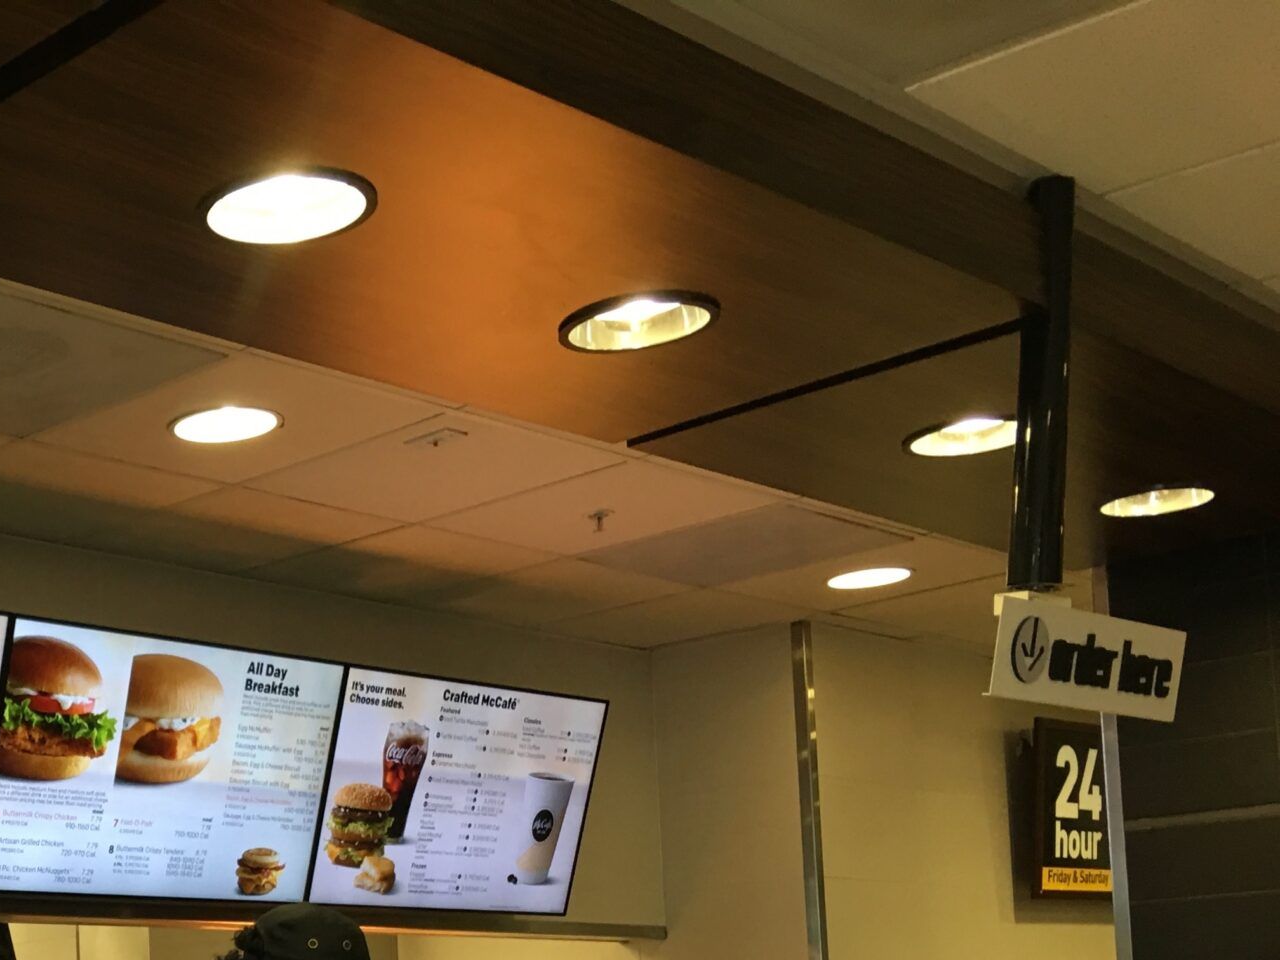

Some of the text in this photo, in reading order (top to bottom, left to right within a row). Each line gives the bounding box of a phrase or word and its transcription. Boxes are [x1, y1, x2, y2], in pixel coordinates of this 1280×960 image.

[247, 661, 288, 681] All Day
[244, 678, 300, 698] Breakfast
[351, 681, 407, 698] It's your meal.
[349, 693, 404, 710] Choose sides.
[443, 689, 517, 710] Crafted McCafé
[1055, 745, 1102, 821] 24
[108, 845, 114, 854] 8
[1055, 820, 1102, 860] hour
[1048, 869, 1109, 886] Friday & Saturday
